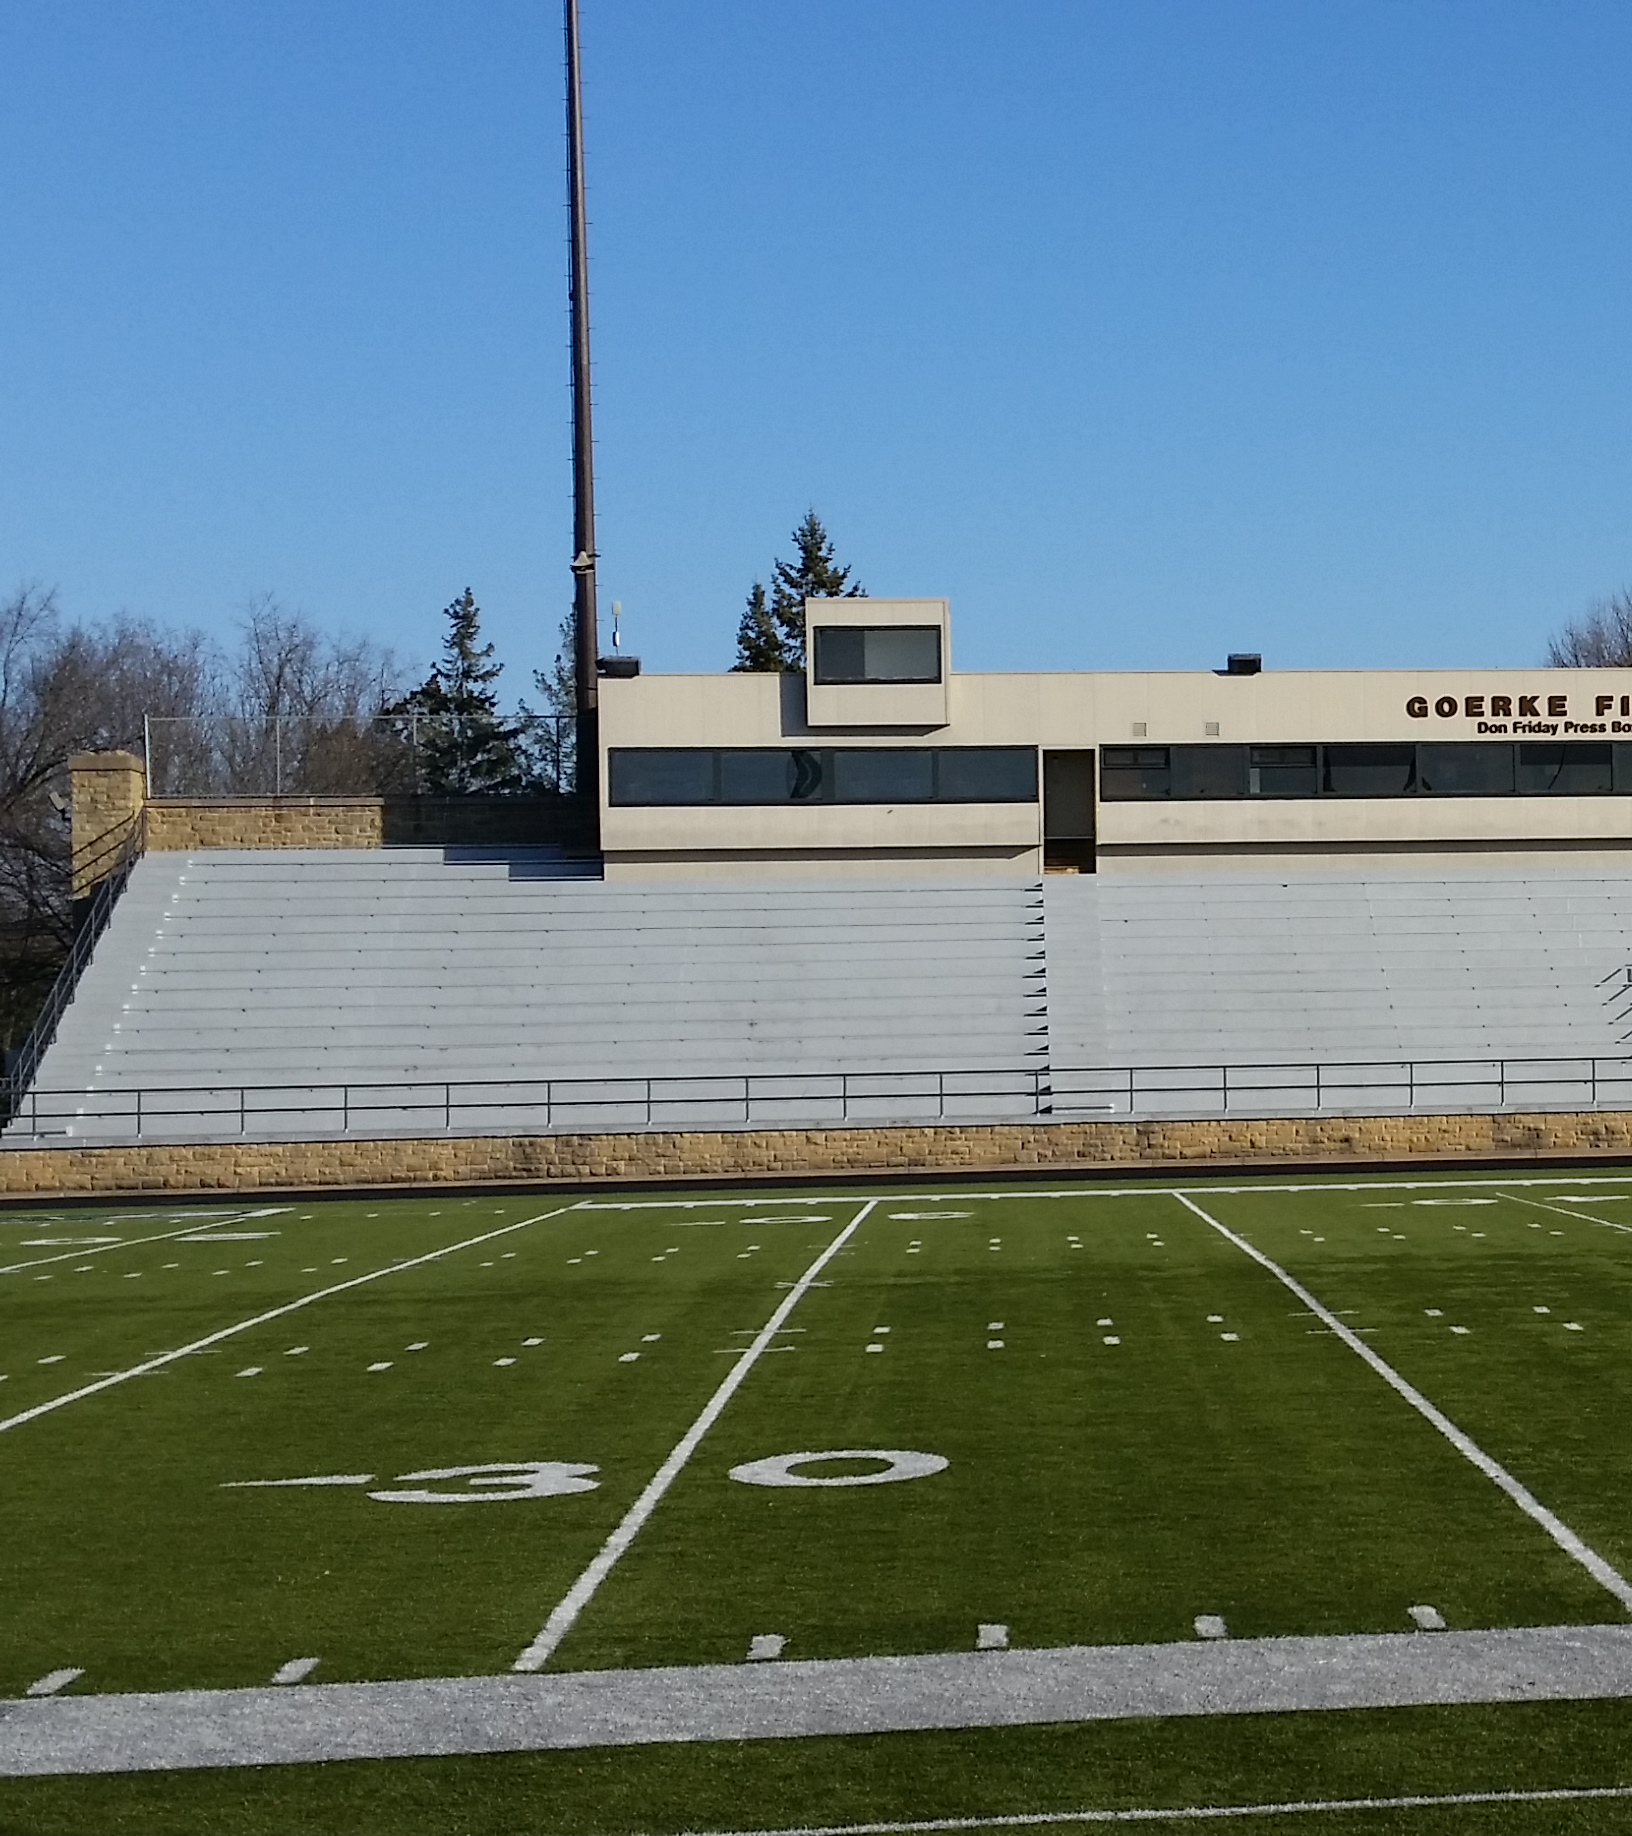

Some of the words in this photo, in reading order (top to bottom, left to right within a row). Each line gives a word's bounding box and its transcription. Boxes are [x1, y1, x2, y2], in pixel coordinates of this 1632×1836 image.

[1405, 695, 1568, 718] GOERKE
[1477, 721, 1508, 734] Don
[1512, 720, 1559, 736] Friday
[1563, 721, 1607, 733] Press
